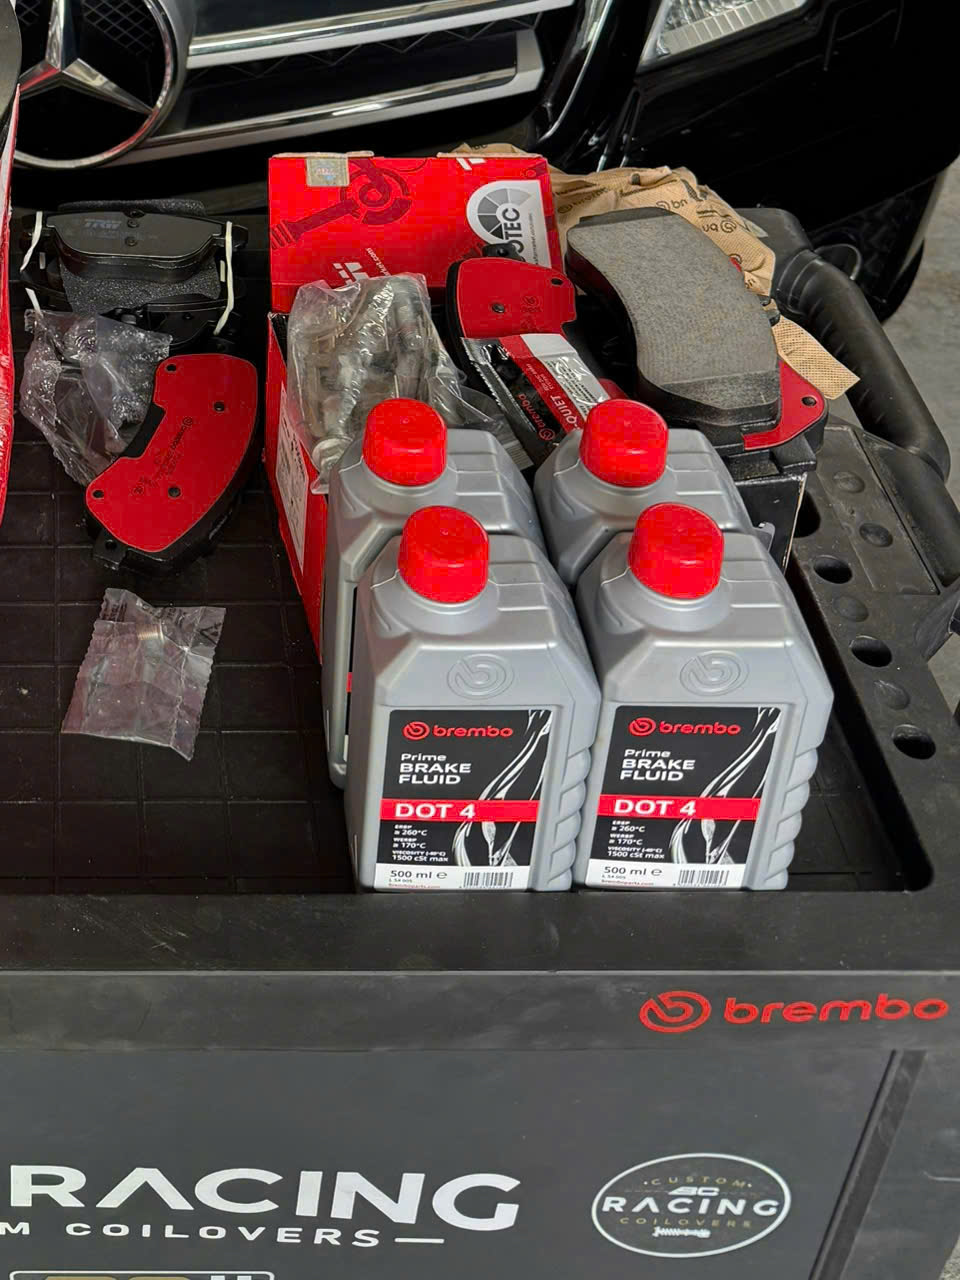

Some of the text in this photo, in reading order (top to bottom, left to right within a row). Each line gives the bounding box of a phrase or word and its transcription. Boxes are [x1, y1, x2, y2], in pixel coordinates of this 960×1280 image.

[432, 725, 513, 737] brembo
[659, 721, 741, 735] brembo
[401, 753, 447, 761] Prime
[624, 749, 671, 758] Prime
[400, 763, 471, 773] BRAKE
[621, 759, 696, 770] BRAKE
[398, 774, 461, 785] FLUID
[620, 770, 684, 781] FLUID
[395, 803, 476, 819] DOT 4
[614, 799, 697, 816] DOT 4
[391, 870, 412, 878] 500
[604, 866, 626, 874] 500
[723, 994, 949, 1024] brembo
[651, 1176, 746, 1187] CUSTOM
[602, 1196, 779, 1216] RACING
[620, 1216, 753, 1229] COILOVERS
[65, 1221, 380, 1247] COILOVERS
